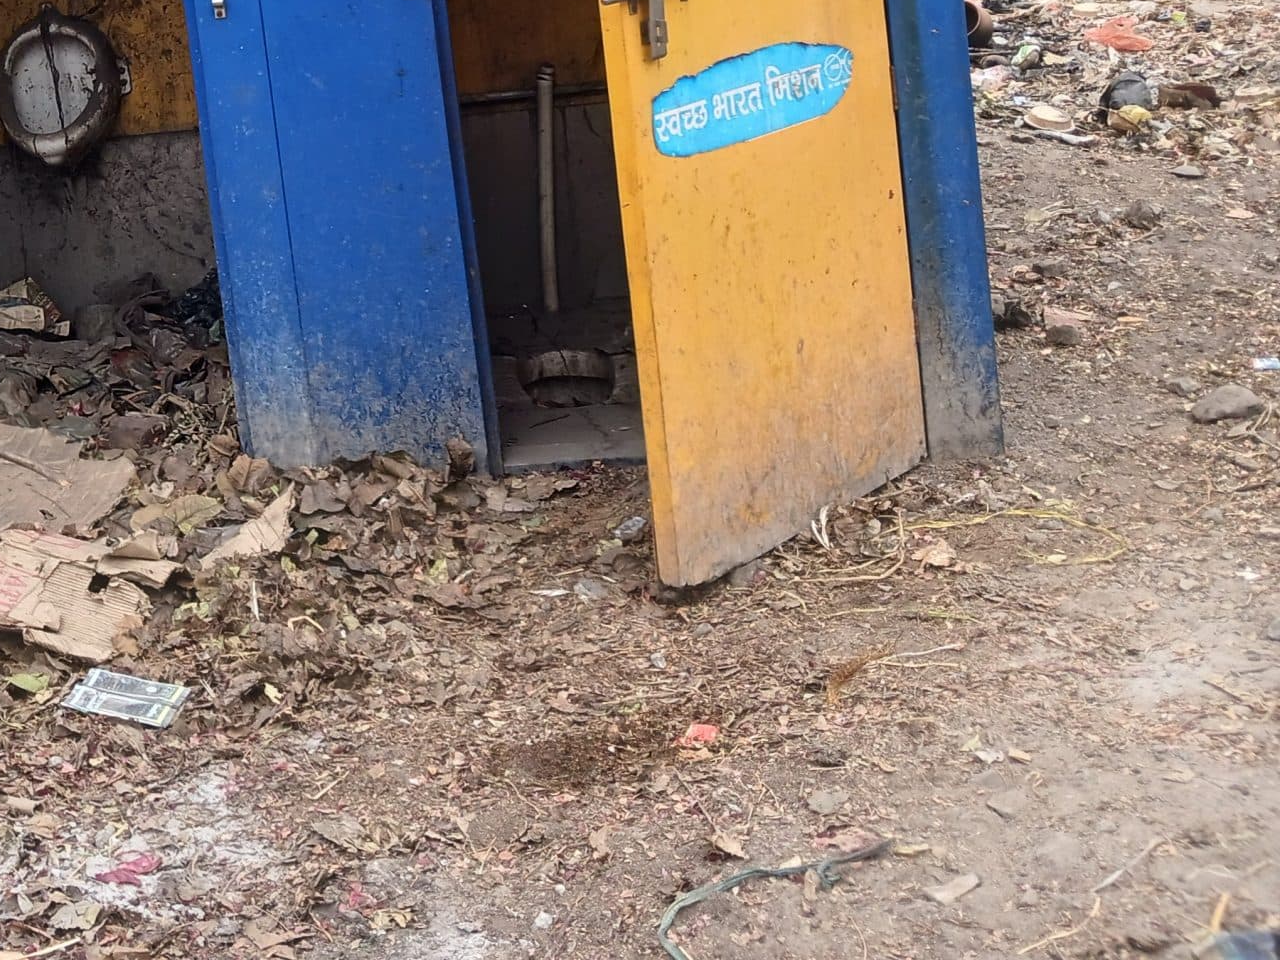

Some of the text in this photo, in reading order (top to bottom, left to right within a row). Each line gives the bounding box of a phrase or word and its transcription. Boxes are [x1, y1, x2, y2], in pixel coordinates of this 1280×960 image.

[654, 64, 824, 142] स्वच्छ भारत मिशन
